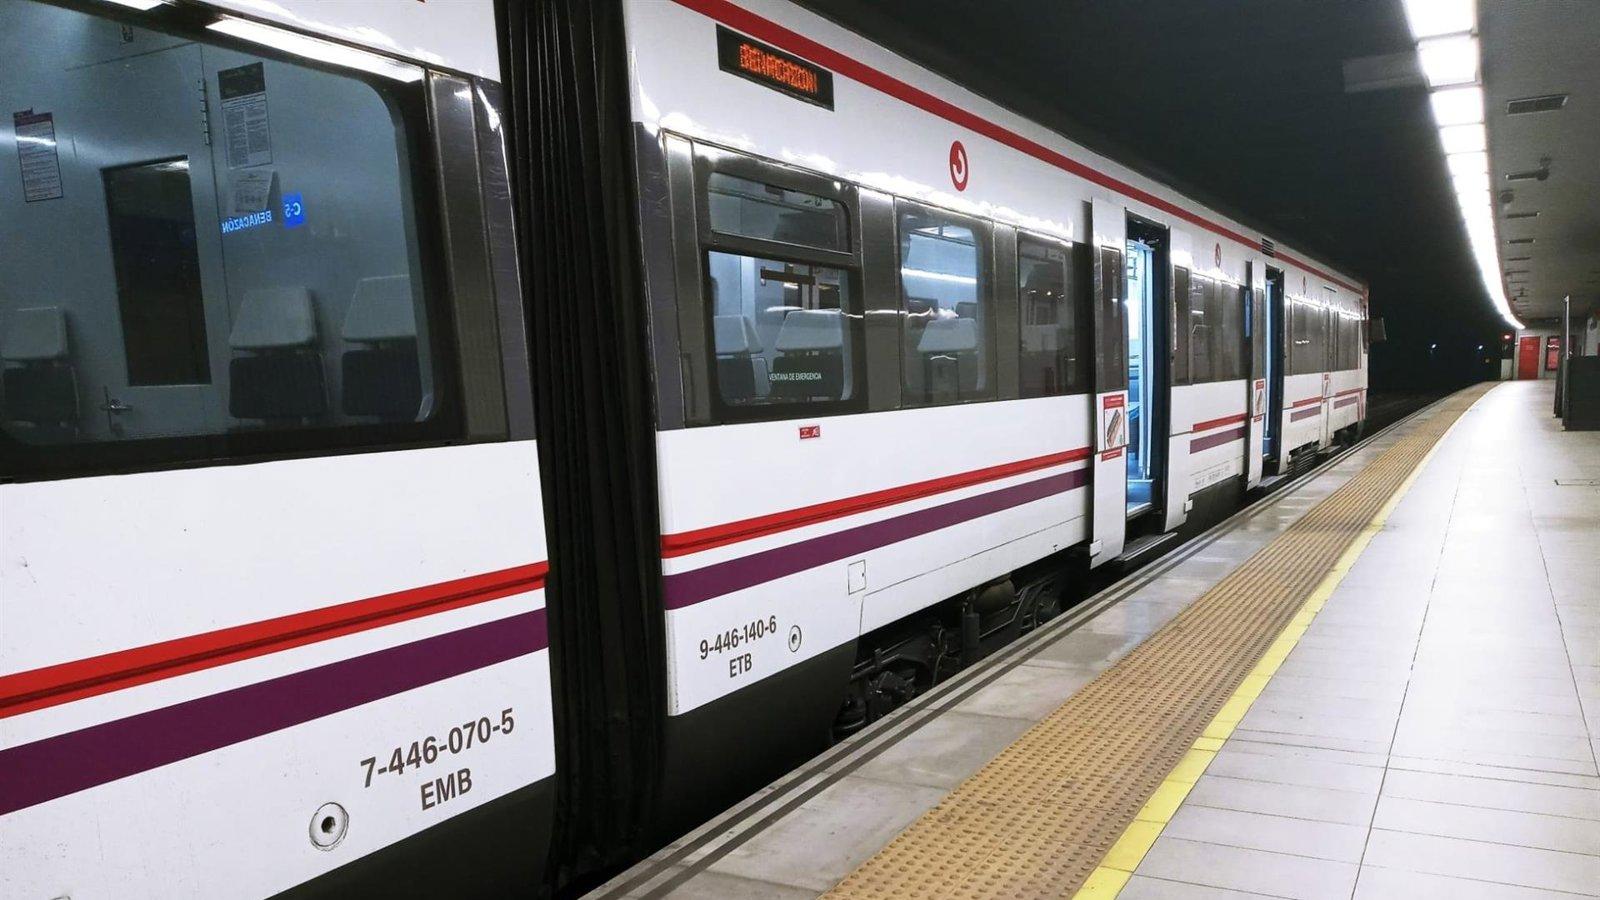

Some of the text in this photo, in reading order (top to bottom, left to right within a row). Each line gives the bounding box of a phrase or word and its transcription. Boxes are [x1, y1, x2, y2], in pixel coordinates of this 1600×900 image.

[769, 372, 822, 381] VENTANA DE EMERGENCIA
[699, 615, 777, 660] 9-446-140-6
[729, 653, 753, 678] ETB
[360, 707, 515, 788] 7-446-070-5
[420, 768, 473, 811] EMB
